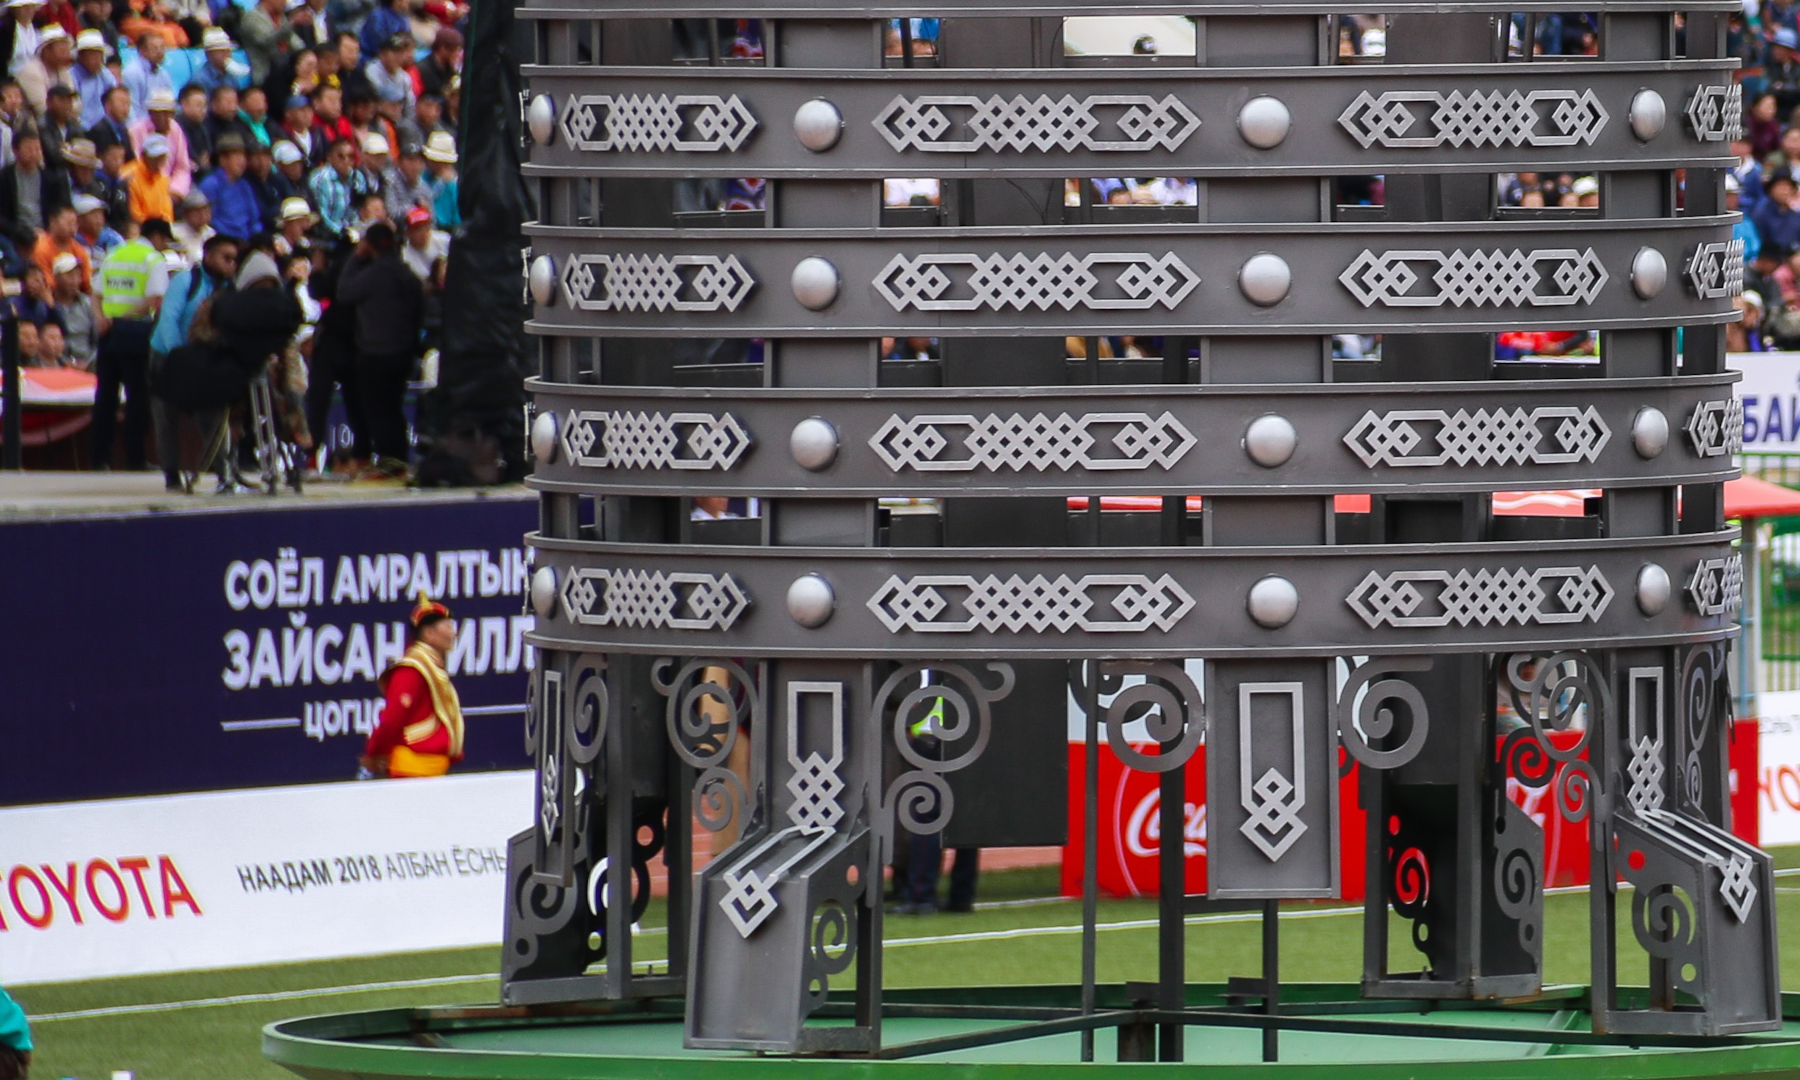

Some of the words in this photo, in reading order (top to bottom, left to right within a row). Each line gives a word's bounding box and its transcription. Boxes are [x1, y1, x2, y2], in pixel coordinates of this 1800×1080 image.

[224, 547, 324, 610] СОЁЛ
[222, 611, 405, 690] ЗАЙСАН
[446, 614, 535, 676] ИЛЛ
[0, 853, 205, 933] OYOTA
[236, 861, 333, 895] НААДАМ
[334, 856, 383, 885] 2018
[384, 850, 452, 881] АЛБАН
